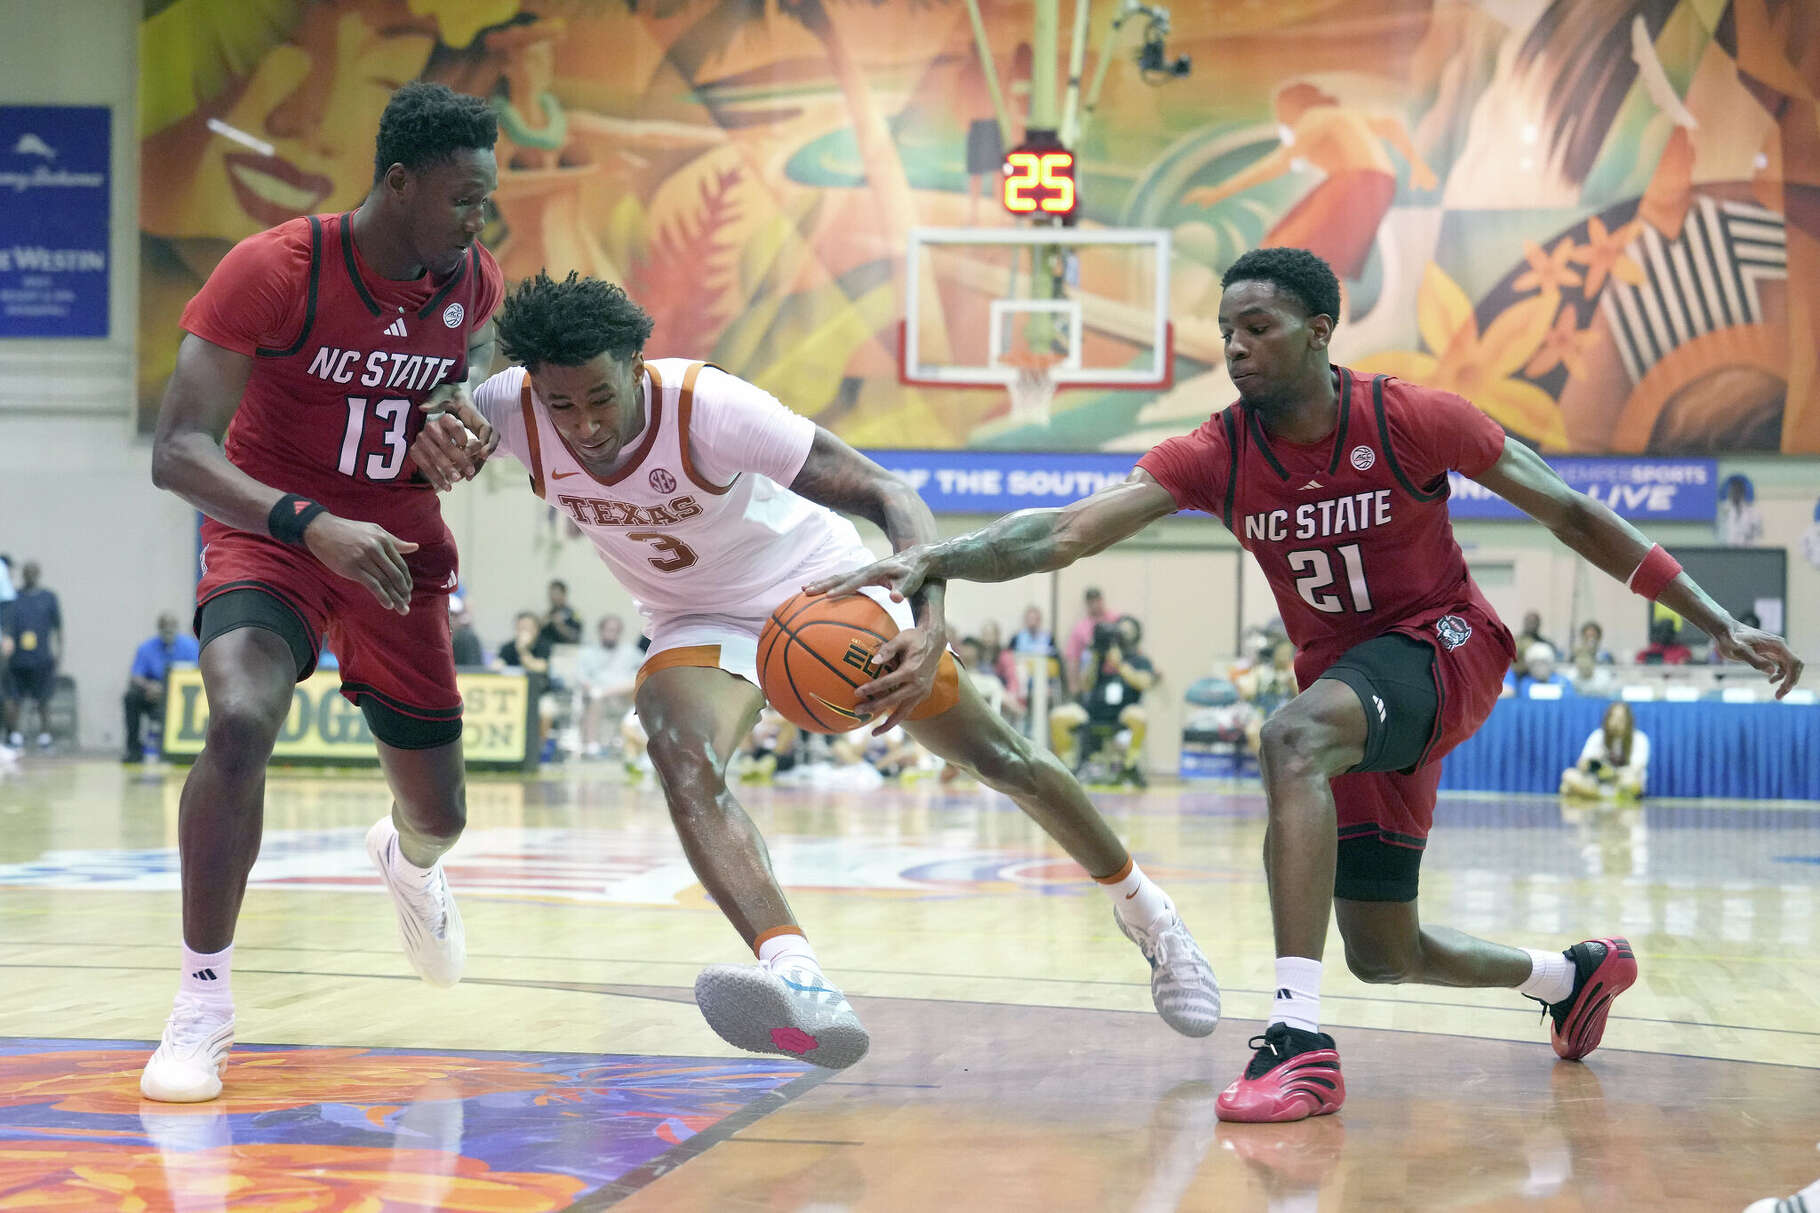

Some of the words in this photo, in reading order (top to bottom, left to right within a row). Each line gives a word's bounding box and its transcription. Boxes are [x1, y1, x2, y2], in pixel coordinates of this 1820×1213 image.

[1004, 153, 1075, 212] 25
[307, 346, 361, 384] NC
[361, 350, 456, 391] STATE
[338, 397, 411, 481] 13
[650, 470, 676, 493] SEC
[936, 468, 1003, 496] THE
[1007, 468, 1127, 496] SOUTH
[1587, 484, 1678, 511] LIVE
[557, 494, 703, 527] TEXAS
[1245, 509, 1288, 541] NC
[1295, 488, 1392, 540] STATE
[625, 531, 699, 574] 3
[1287, 543, 1373, 613] 21
